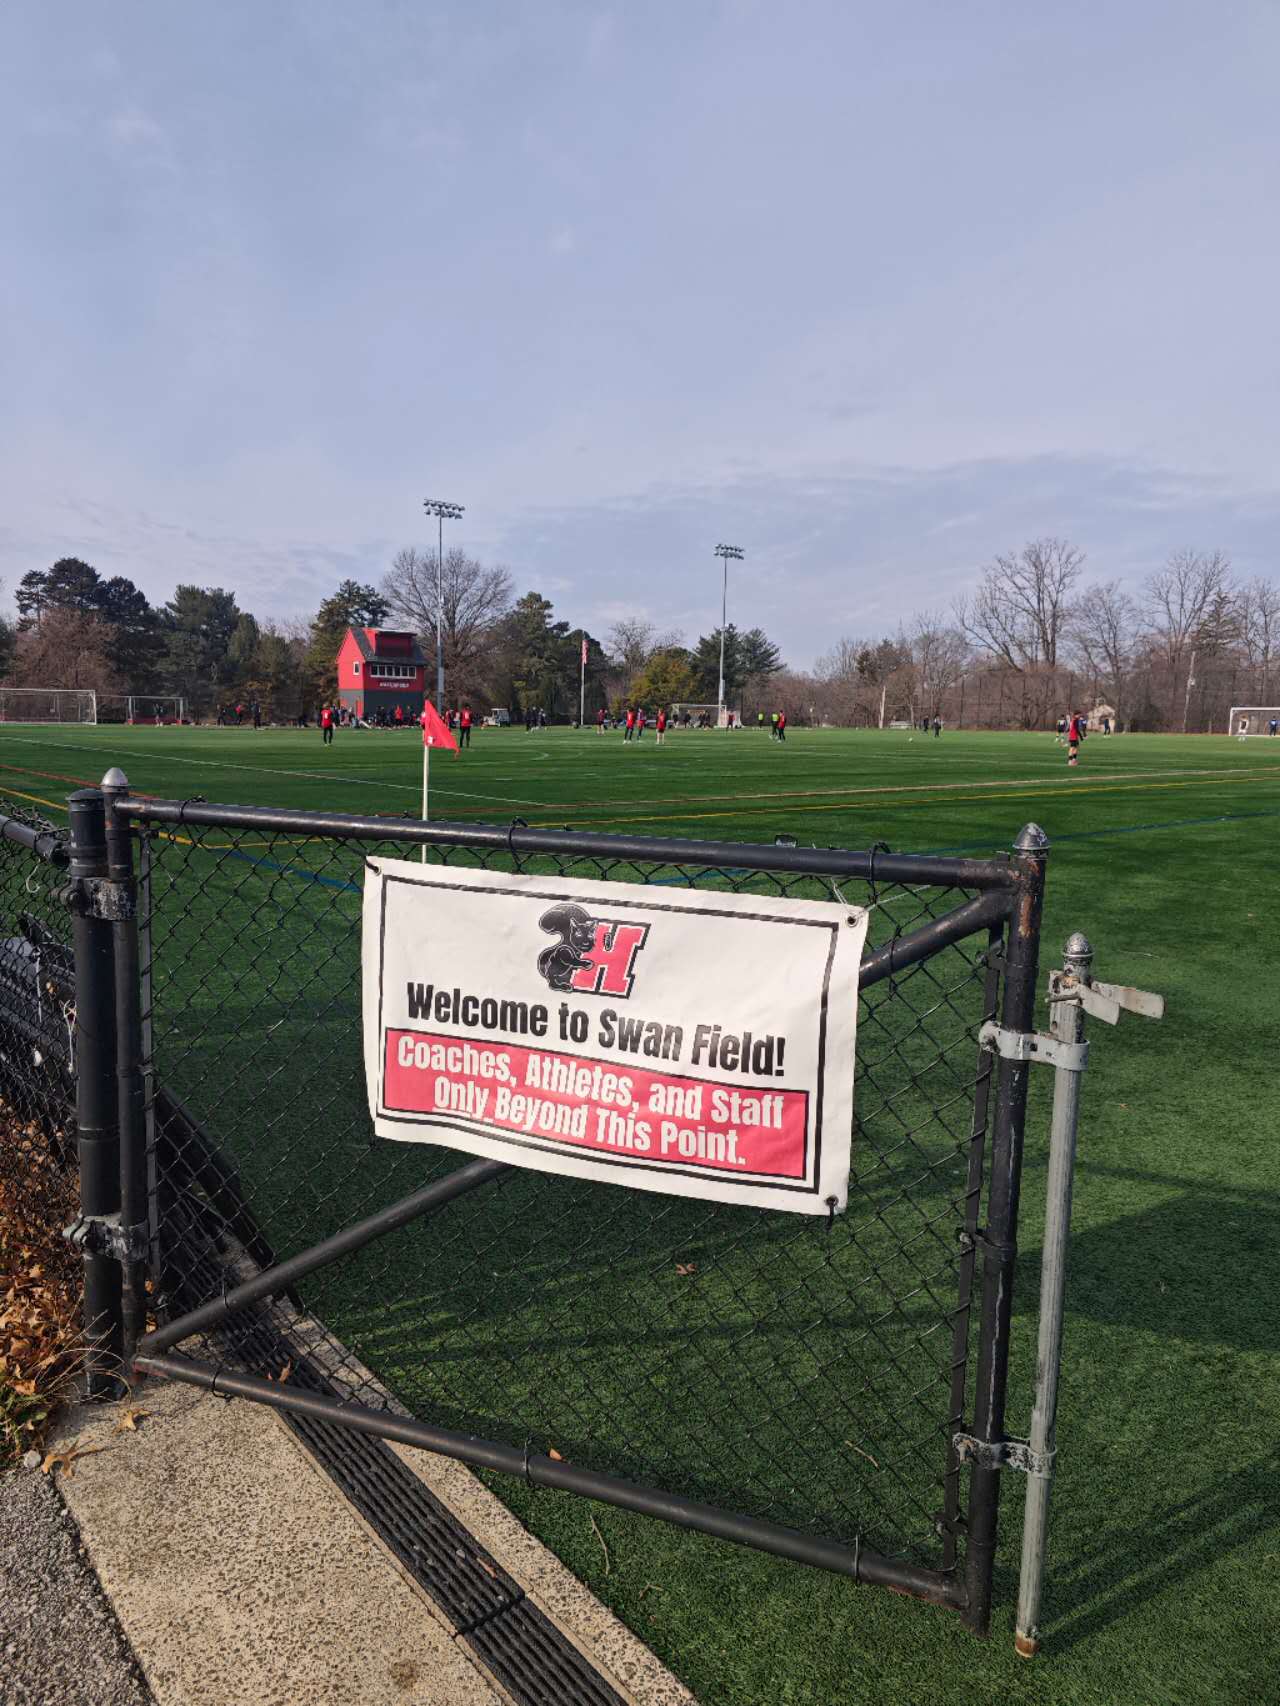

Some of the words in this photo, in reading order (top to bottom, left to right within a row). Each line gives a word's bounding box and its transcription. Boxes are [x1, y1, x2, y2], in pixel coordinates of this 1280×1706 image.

[570, 917, 651, 999] H
[407, 982, 548, 1037] Welcome
[559, 1002, 590, 1043] to
[599, 1009, 683, 1062] Swan
[691, 1025, 786, 1077] Field!
[398, 1036, 517, 1087] Coaches,
[525, 1054, 640, 1114] Athletes,
[648, 1083, 703, 1121] and
[711, 1089, 785, 1129] Staff
[434, 1076, 491, 1120] Only
[495, 1087, 589, 1139] Beyond
[596, 1108, 652, 1151] This
[660, 1121, 746, 1165] Point.
